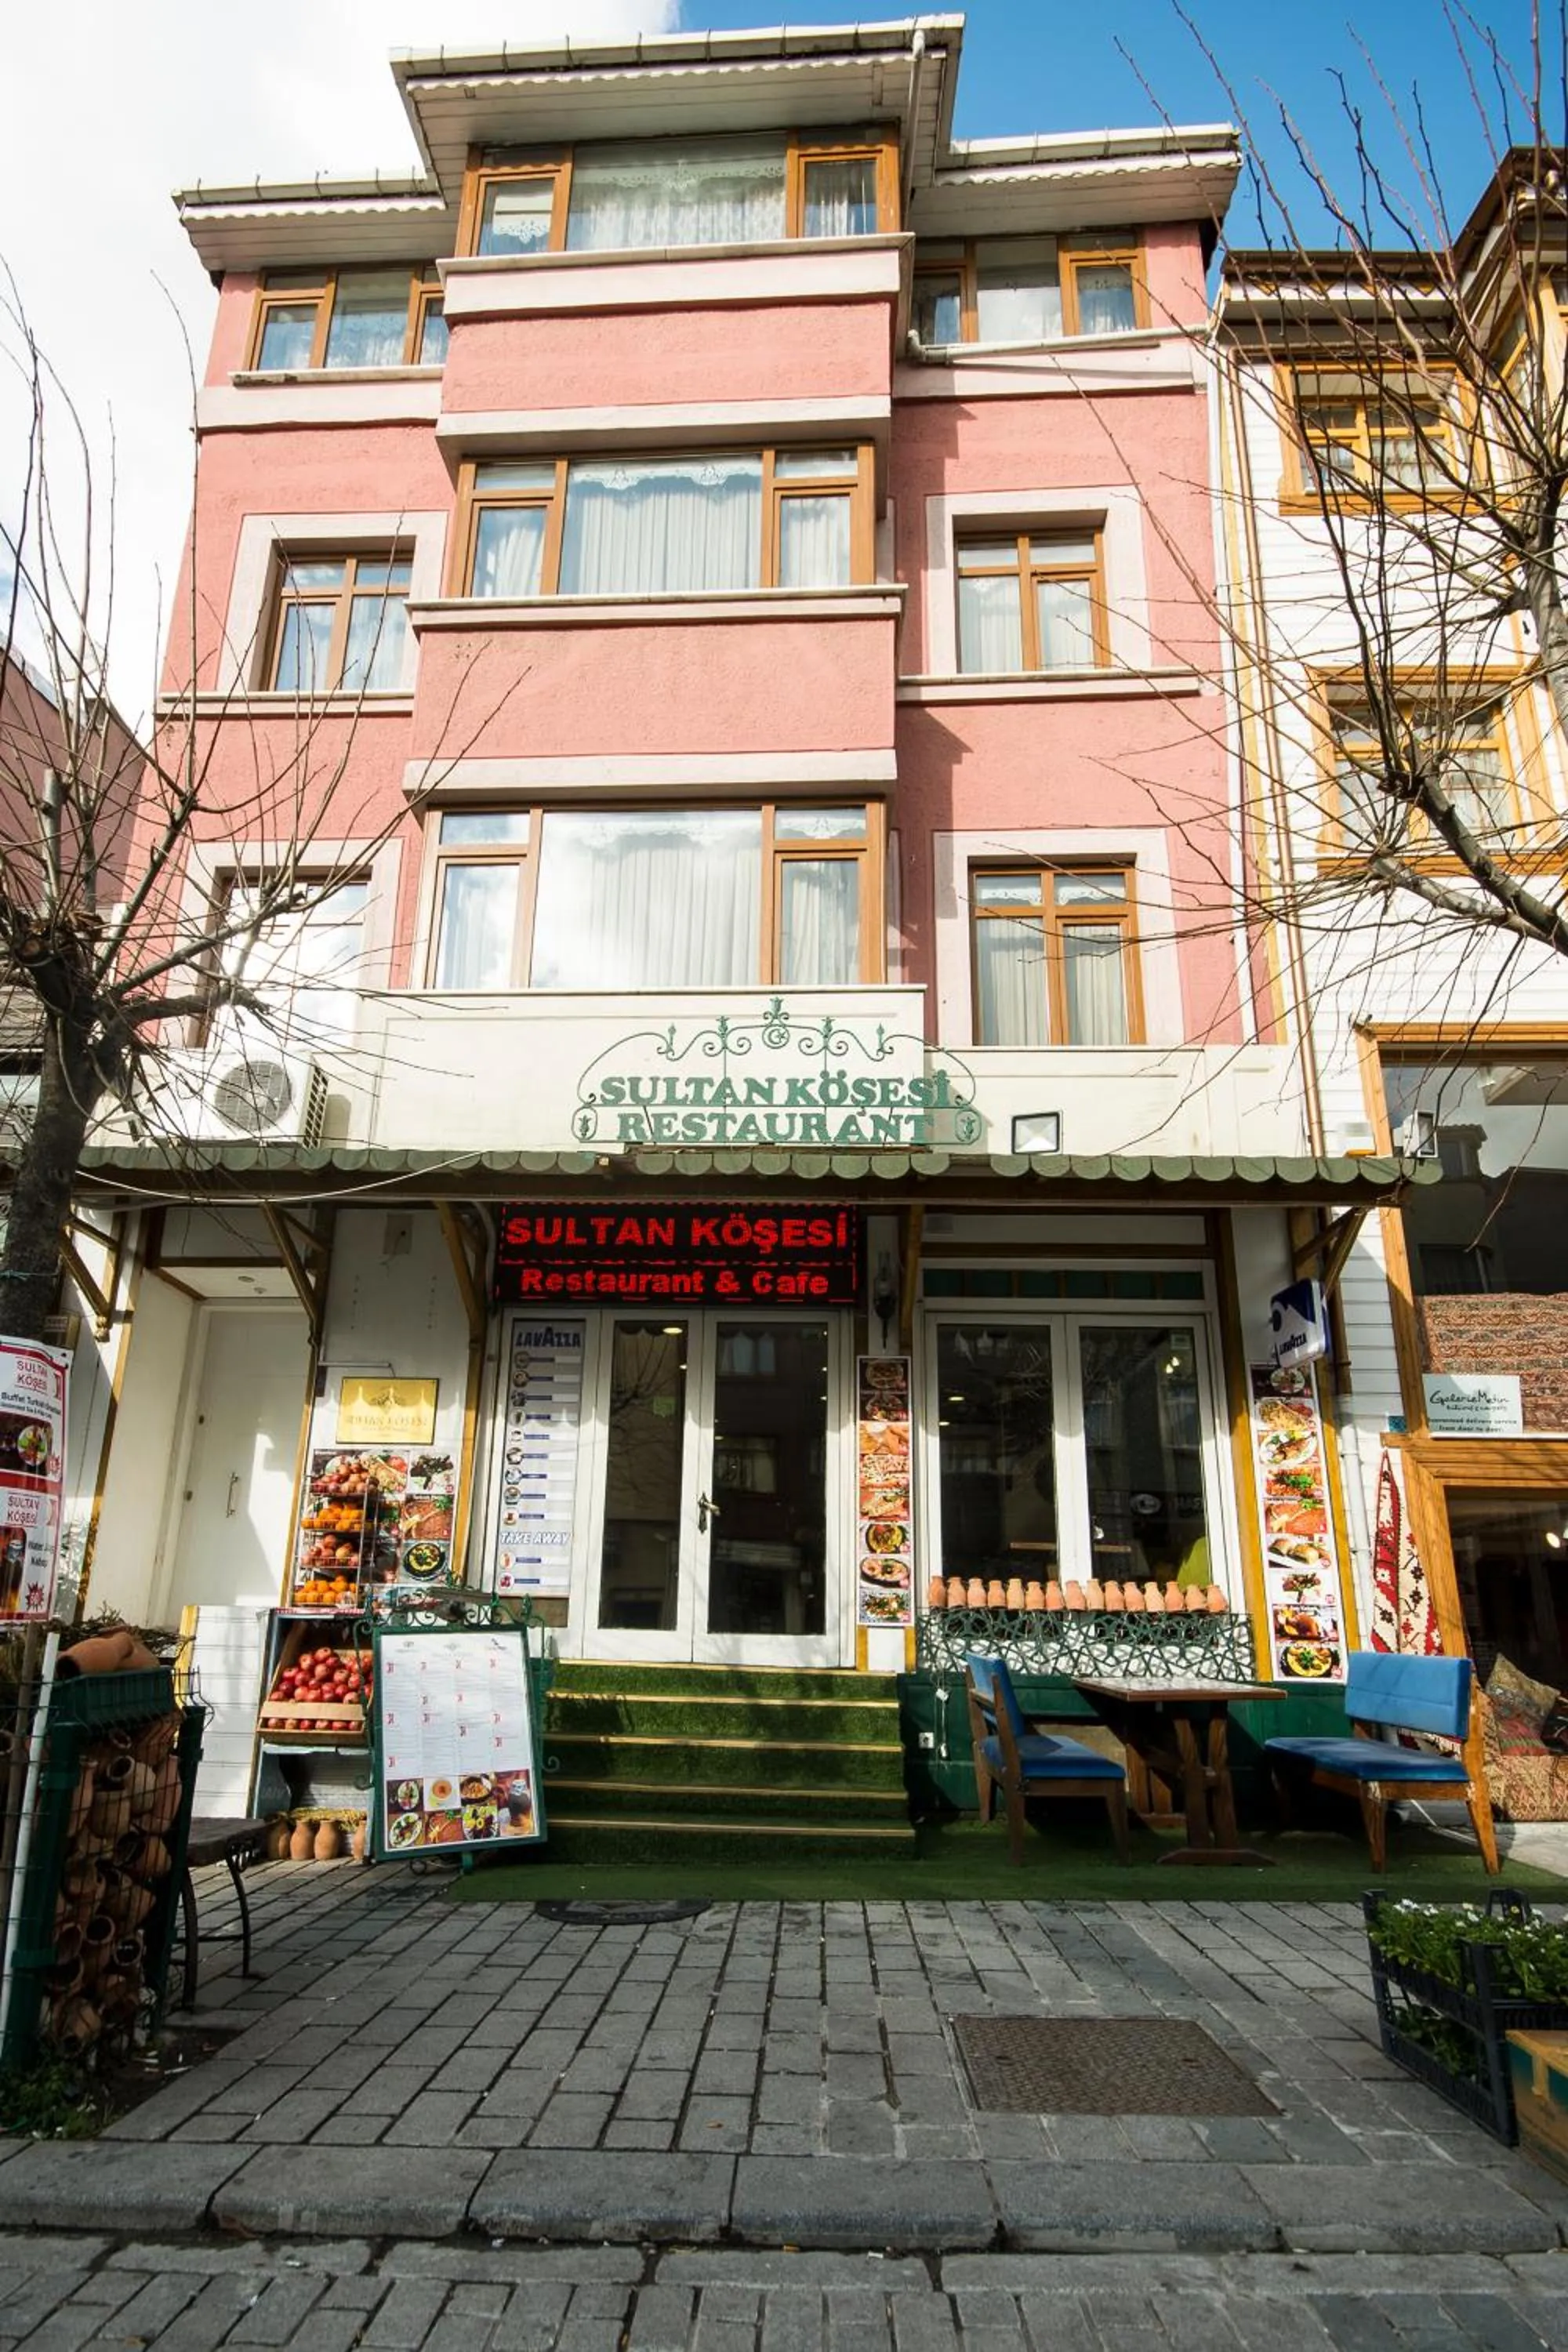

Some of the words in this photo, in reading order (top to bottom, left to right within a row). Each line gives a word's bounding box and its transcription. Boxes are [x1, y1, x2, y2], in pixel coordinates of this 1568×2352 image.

[600, 1076, 780, 1106] SULTAN
[786, 1069, 952, 1116] KÖŞESİ
[617, 1112, 935, 1143] RESTAURANT
[506, 1218, 675, 1247] SULTAN
[691, 1212, 847, 1254] KÖŞESİ
[521, 1268, 703, 1294] Restaurant
[714, 1270, 740, 1294] &
[752, 1270, 829, 1295] Cafe
[515, 1327, 581, 1348] LAVAZZA
[499, 1531, 532, 1544] TAKE
[533, 1530, 571, 1544] AWAY
